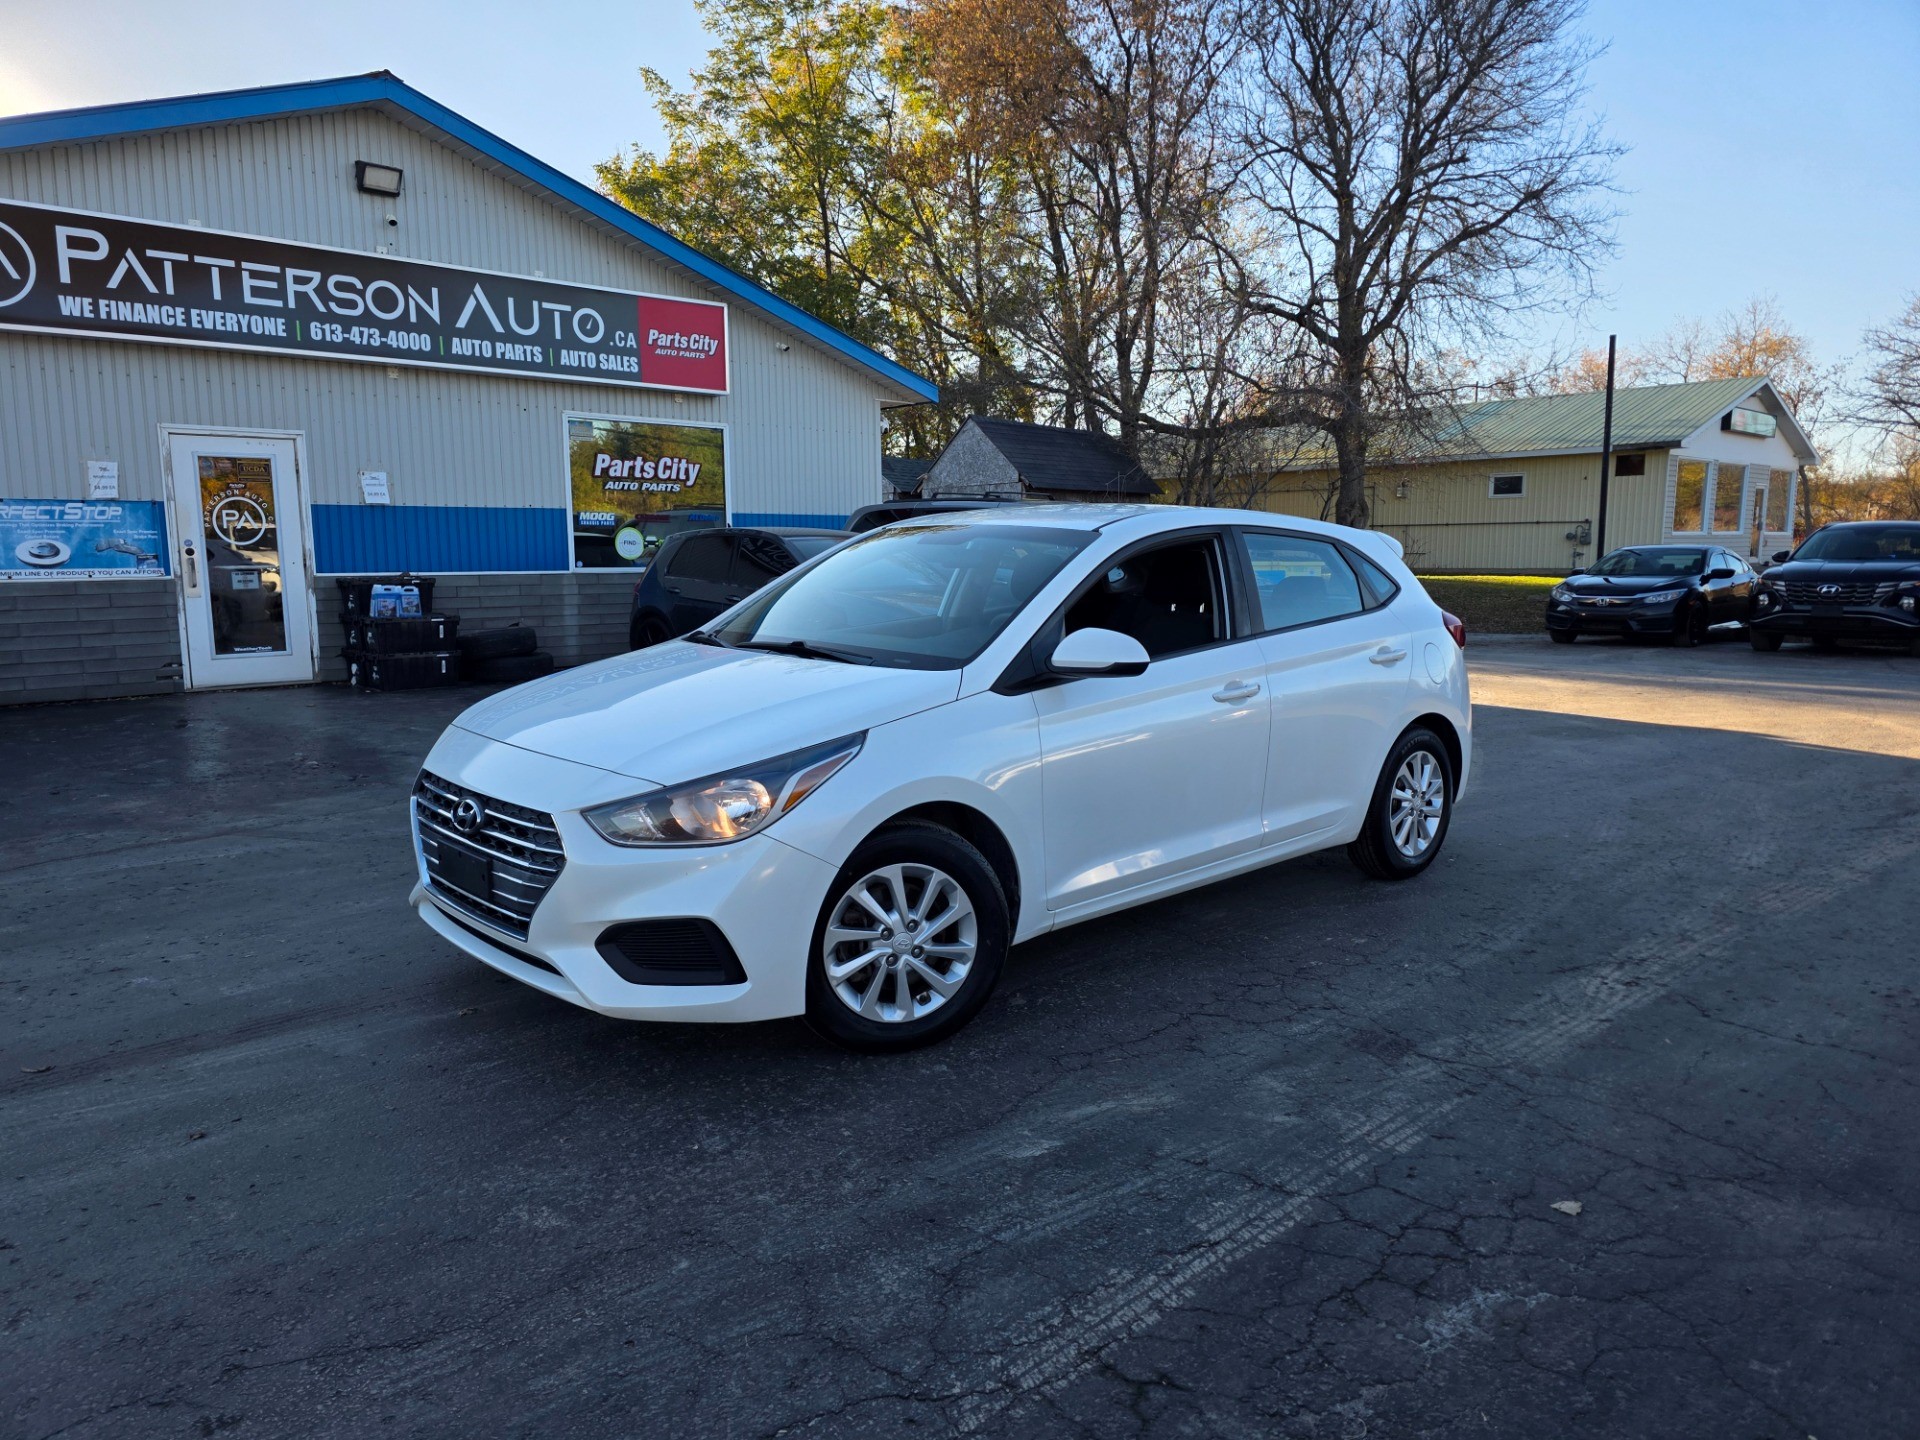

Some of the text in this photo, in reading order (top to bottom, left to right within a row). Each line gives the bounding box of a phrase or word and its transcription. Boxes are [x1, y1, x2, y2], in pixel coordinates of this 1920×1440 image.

[55, 224, 442, 326] PATTERSON
[455, 282, 605, 344] AUTO
[58, 295, 639, 373] WE FINANCE EVERYONE 613-473-4000 AUTO PARTS AUTO SALES
[655, 348, 706, 359] AUTO PARTS
[605, 481, 681, 492] AUTO PARTS
[204, 489, 239, 528] PATTERSON
[245, 491, 268, 509] AUTO
[579, 511, 615, 521] MOOG
[221, 509, 259, 529] PA
